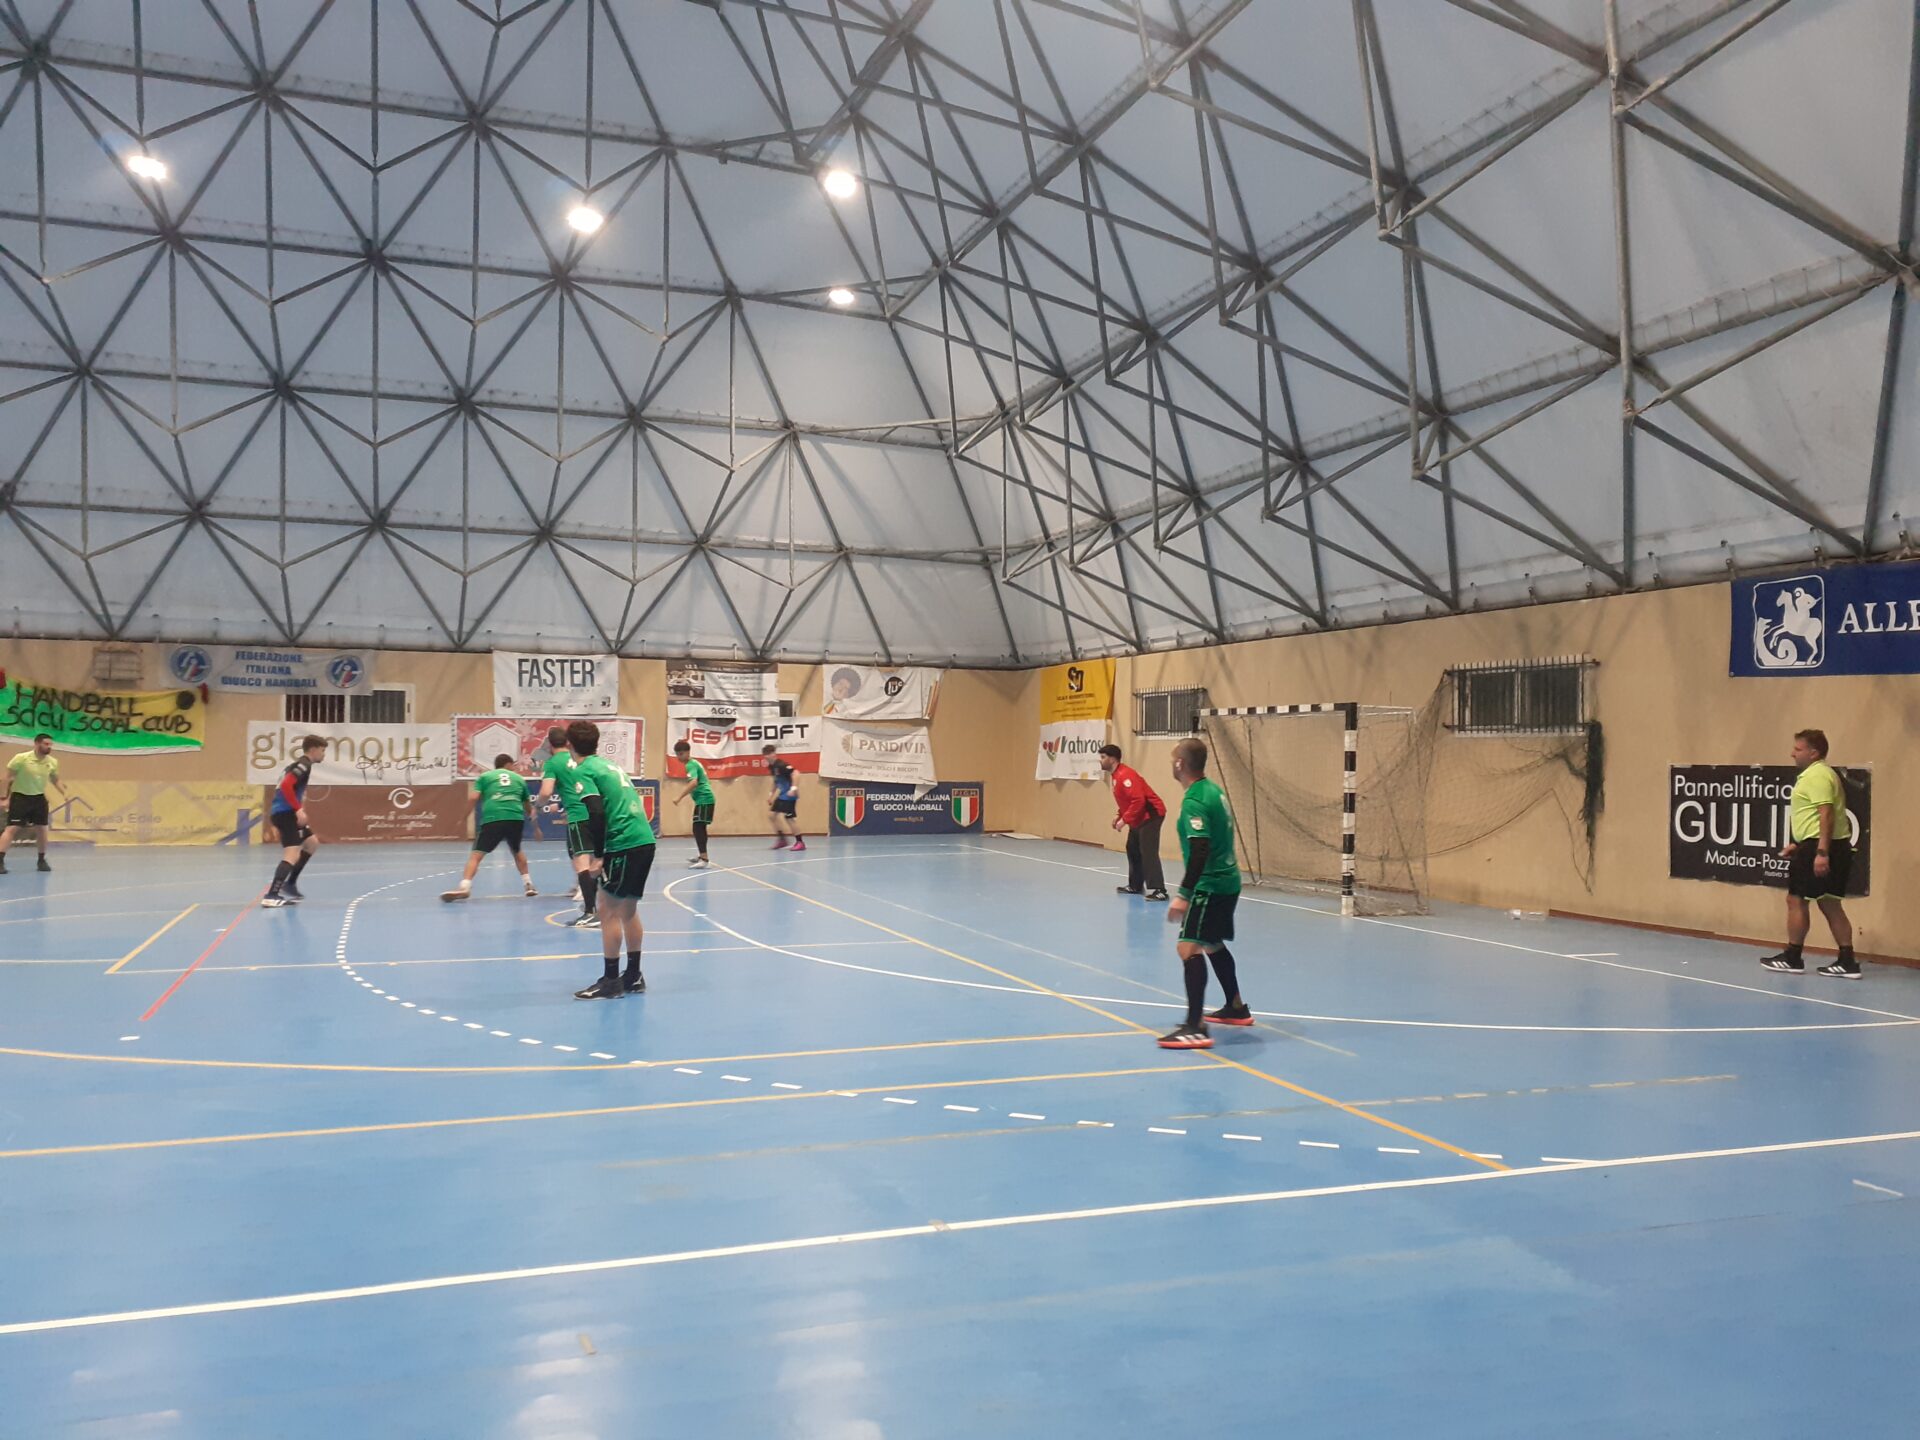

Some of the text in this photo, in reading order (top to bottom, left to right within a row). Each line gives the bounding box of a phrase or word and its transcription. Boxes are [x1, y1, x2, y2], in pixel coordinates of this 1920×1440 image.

[235, 651, 303, 663] FEDERAZIONE
[245, 665, 291, 675] ITALIANA
[518, 658, 595, 687] FASTER
[221, 676, 317, 688] GIUOCO HANDBALL
[15, 682, 143, 717] HANDBALL
[142, 715, 192, 734] CLUB
[500, 773, 510, 786] 8
[1675, 775, 1794, 800] Pannellificio
[873, 803, 944, 811] GIUOCO HANDBALL
[1705, 850, 1791, 871] Modica-Pozz
